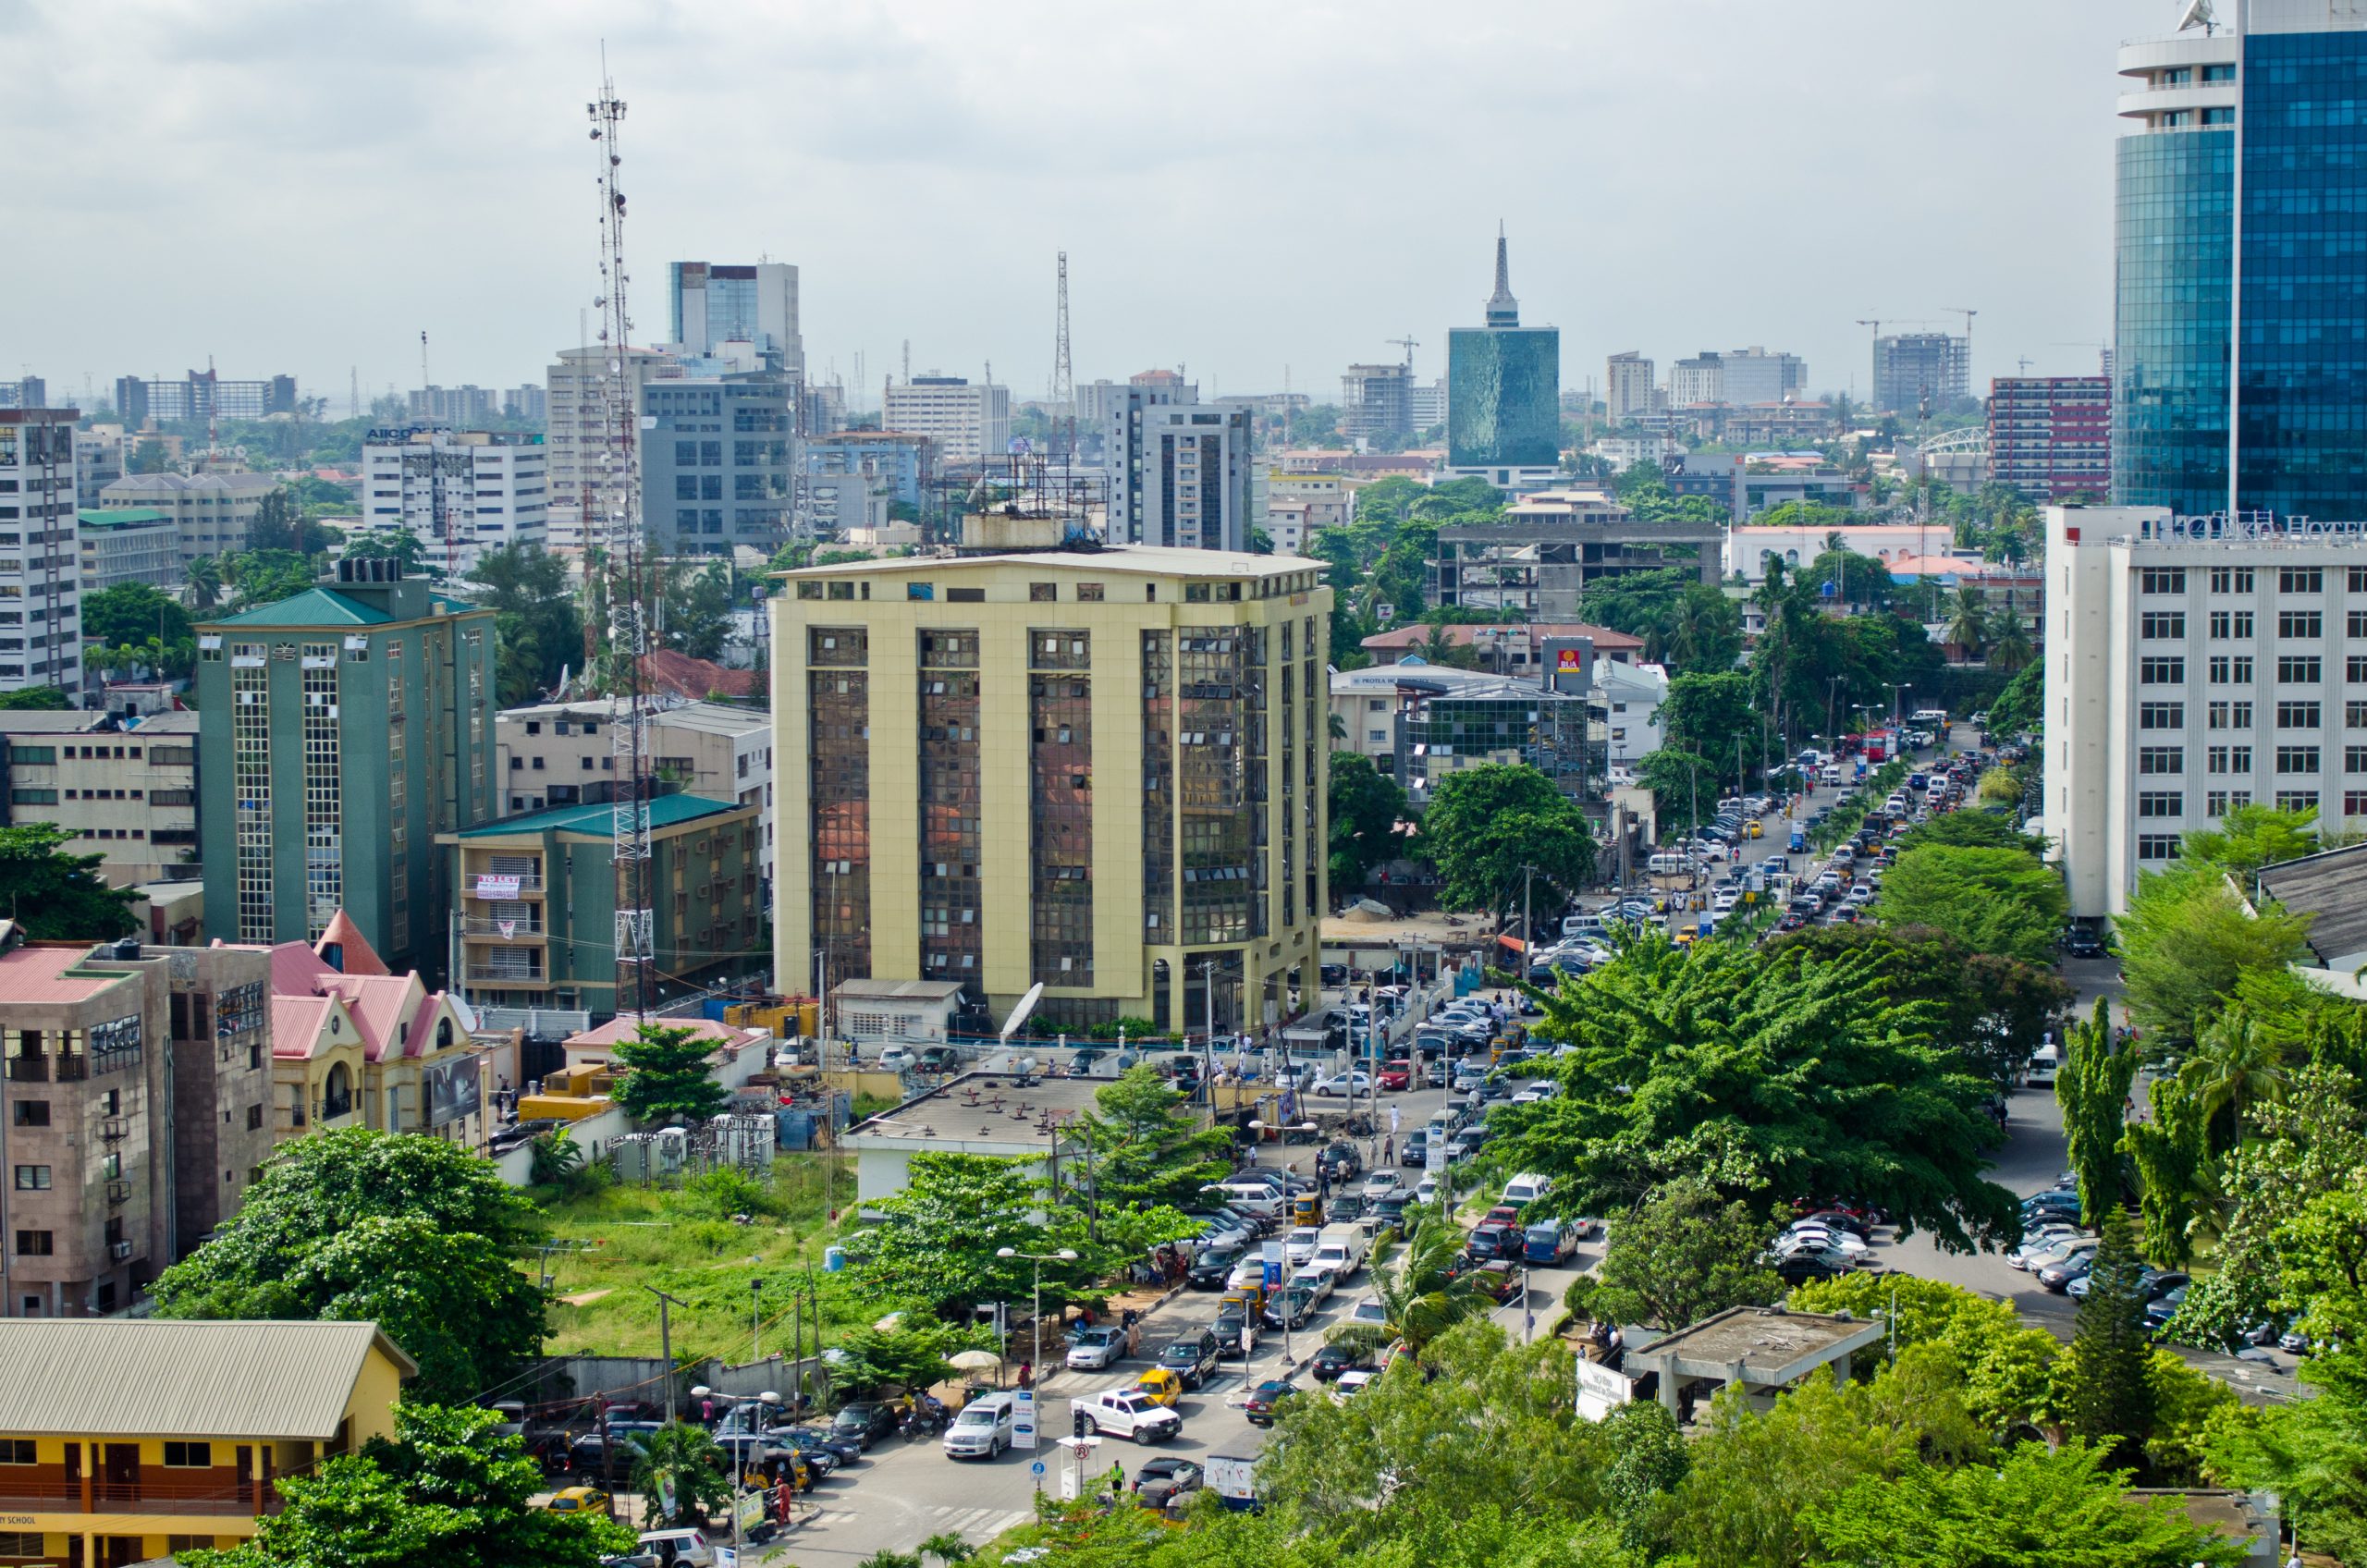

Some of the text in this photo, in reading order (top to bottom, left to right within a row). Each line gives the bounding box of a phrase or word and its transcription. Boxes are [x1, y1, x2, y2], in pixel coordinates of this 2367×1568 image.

[1561, 660, 1577, 668] BUA
[497, 876, 517, 884] LET
[7, 1515, 36, 1525] SCHOOL
